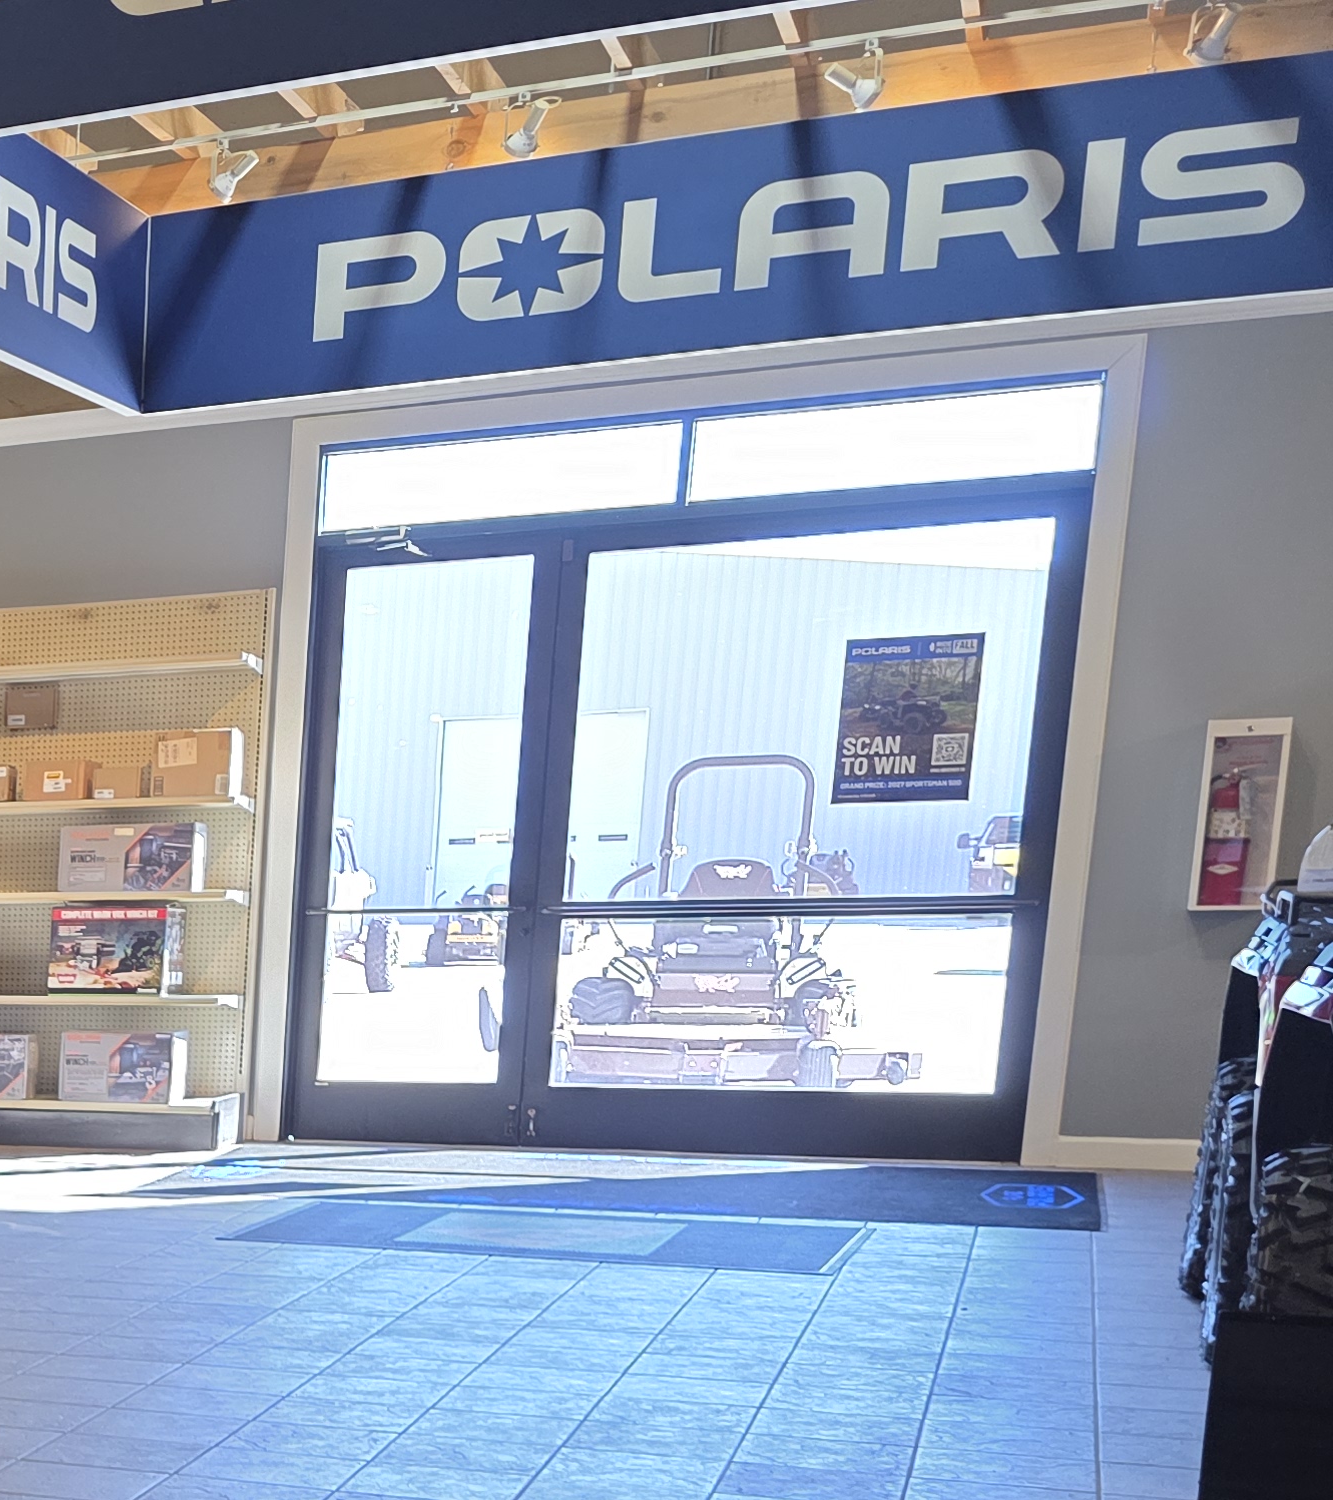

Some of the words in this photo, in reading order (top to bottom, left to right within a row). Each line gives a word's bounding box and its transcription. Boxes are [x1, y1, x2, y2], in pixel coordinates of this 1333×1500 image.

[313, 118, 1306, 343] POLARIS
[851, 645, 911, 657] POLARIS
[843, 735, 901, 756] SCAN
[841, 757, 869, 776] TO
[874, 755, 917, 775] WIN
